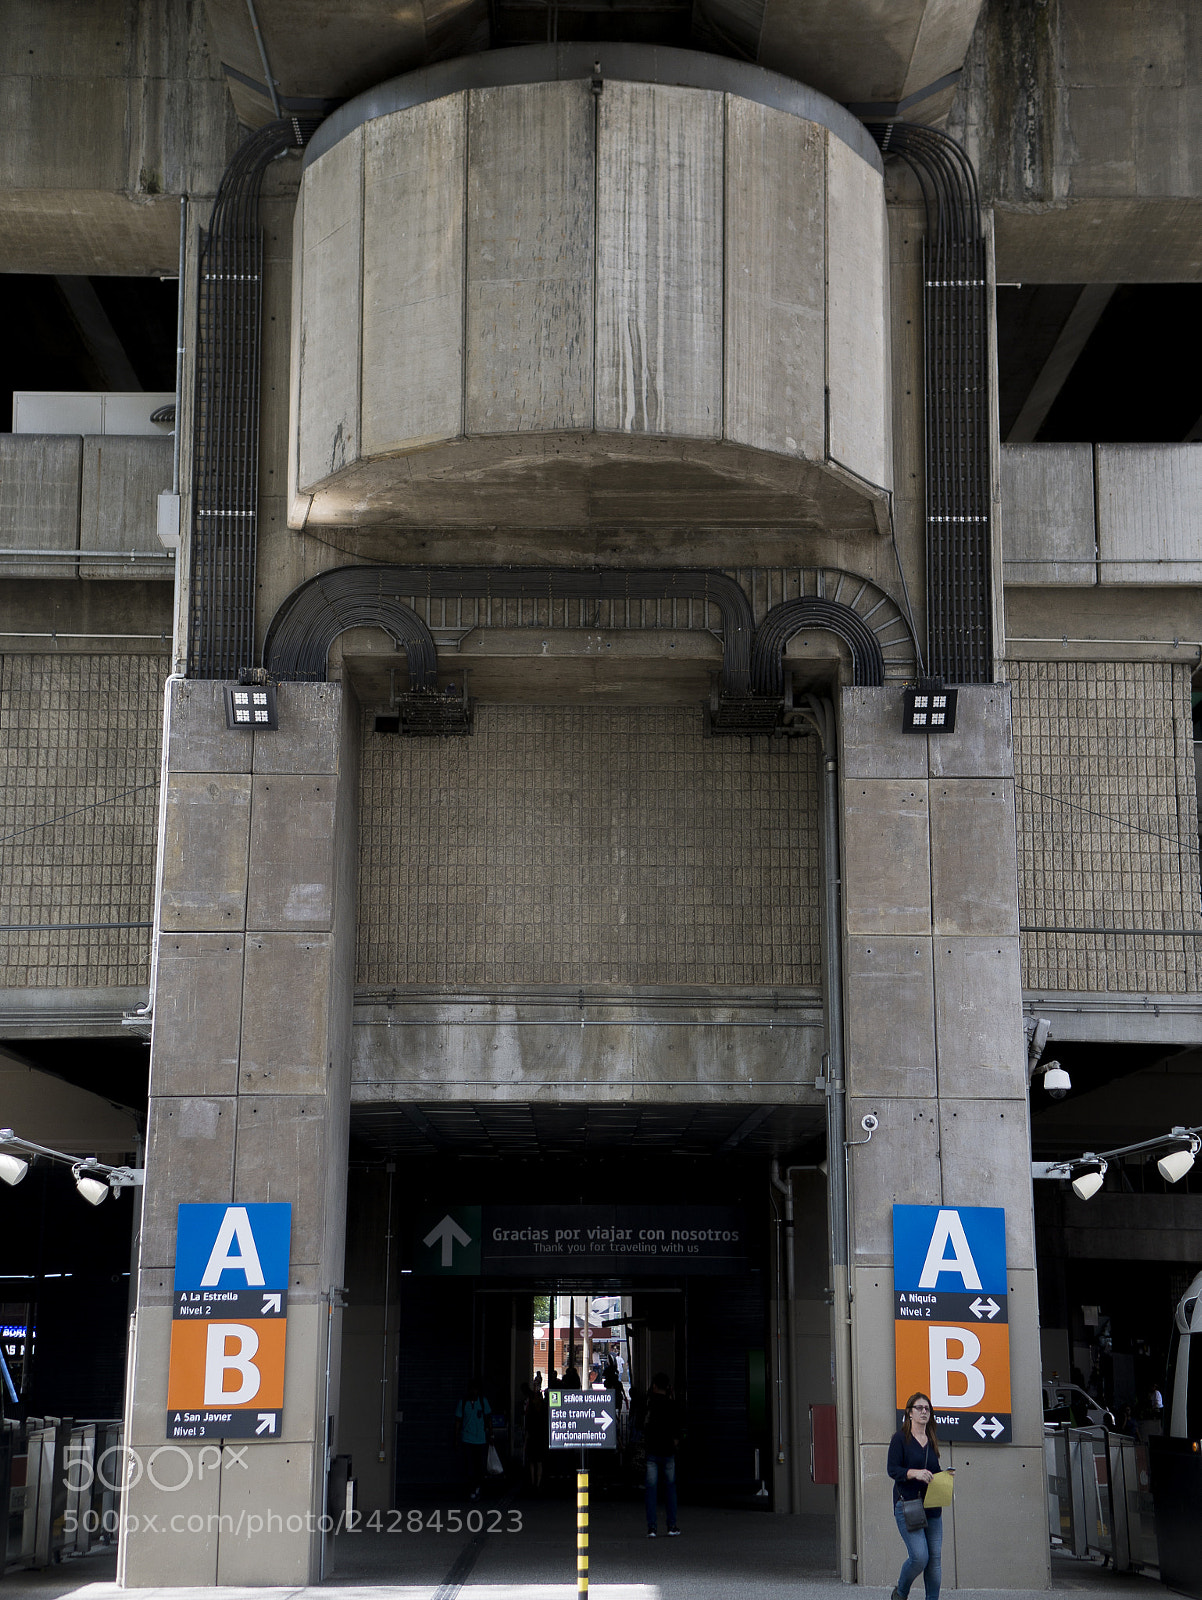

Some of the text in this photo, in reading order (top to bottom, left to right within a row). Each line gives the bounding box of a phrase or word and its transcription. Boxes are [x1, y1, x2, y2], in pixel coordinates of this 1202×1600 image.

[492, 1226, 740, 1243] Gracias por viajar con nosotros
[200, 1207, 266, 1287] A
[533, 1242, 700, 1254] Thank you for traveling with us
[918, 1210, 983, 1290] A
[180, 1292, 238, 1301] A La Estrella
[899, 1294, 937, 1304] A Niquía
[180, 1306, 212, 1315] Nivel 2
[900, 1307, 931, 1317] Nivel 2
[203, 1323, 261, 1406] B
[928, 1325, 986, 1408] B
[563, 1393, 612, 1403] SEÑOR USUARIO
[174, 1412, 233, 1422] A San Javier
[551, 1408, 596, 1418] Este tranvía
[551, 1420, 577, 1429] esta en
[173, 1427, 206, 1436] Nivel 3
[551, 1430, 607, 1441] funcionamiento
